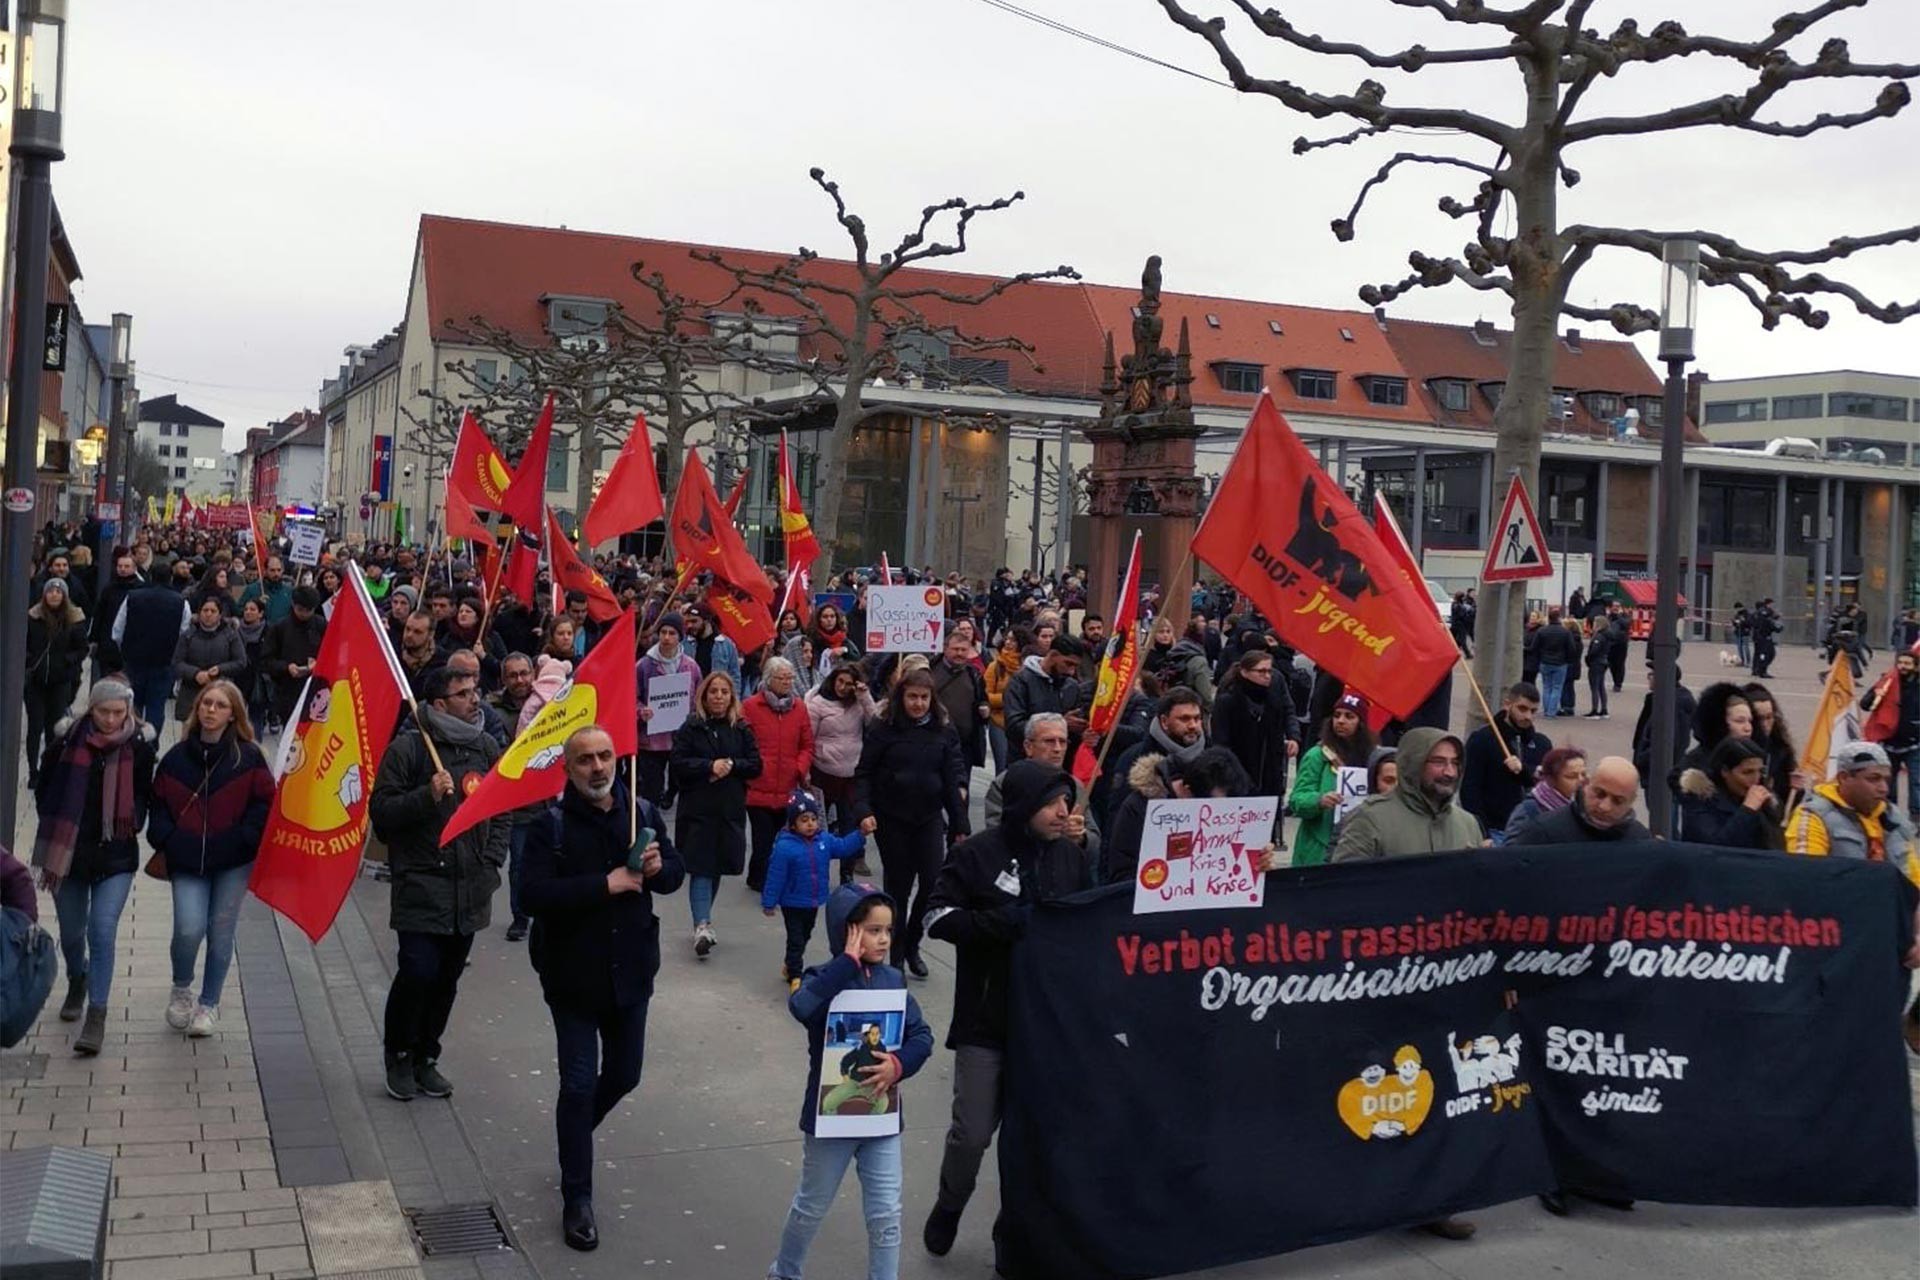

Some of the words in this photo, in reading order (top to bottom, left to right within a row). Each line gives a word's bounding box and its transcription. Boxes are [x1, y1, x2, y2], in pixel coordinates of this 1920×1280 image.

[1344, 694, 1359, 707] M
[1199, 804, 1271, 828] Rassismus
[1160, 878, 1194, 901] und
[1117, 927, 1235, 975] Verbot
[1246, 924, 1331, 963] aller
[1342, 910, 1549, 959] rassistischen
[1558, 905, 1616, 943] und
[1623, 902, 1841, 946] faschistischen
[1200, 949, 1497, 1022] Organisationen
[1503, 943, 1595, 976] und
[1602, 939, 1791, 983] Parteien!
[1546, 1026, 1625, 1054] SOLI
[1546, 1047, 1689, 1080] DARITÄT
[1361, 1089, 1419, 1116] DIDF
